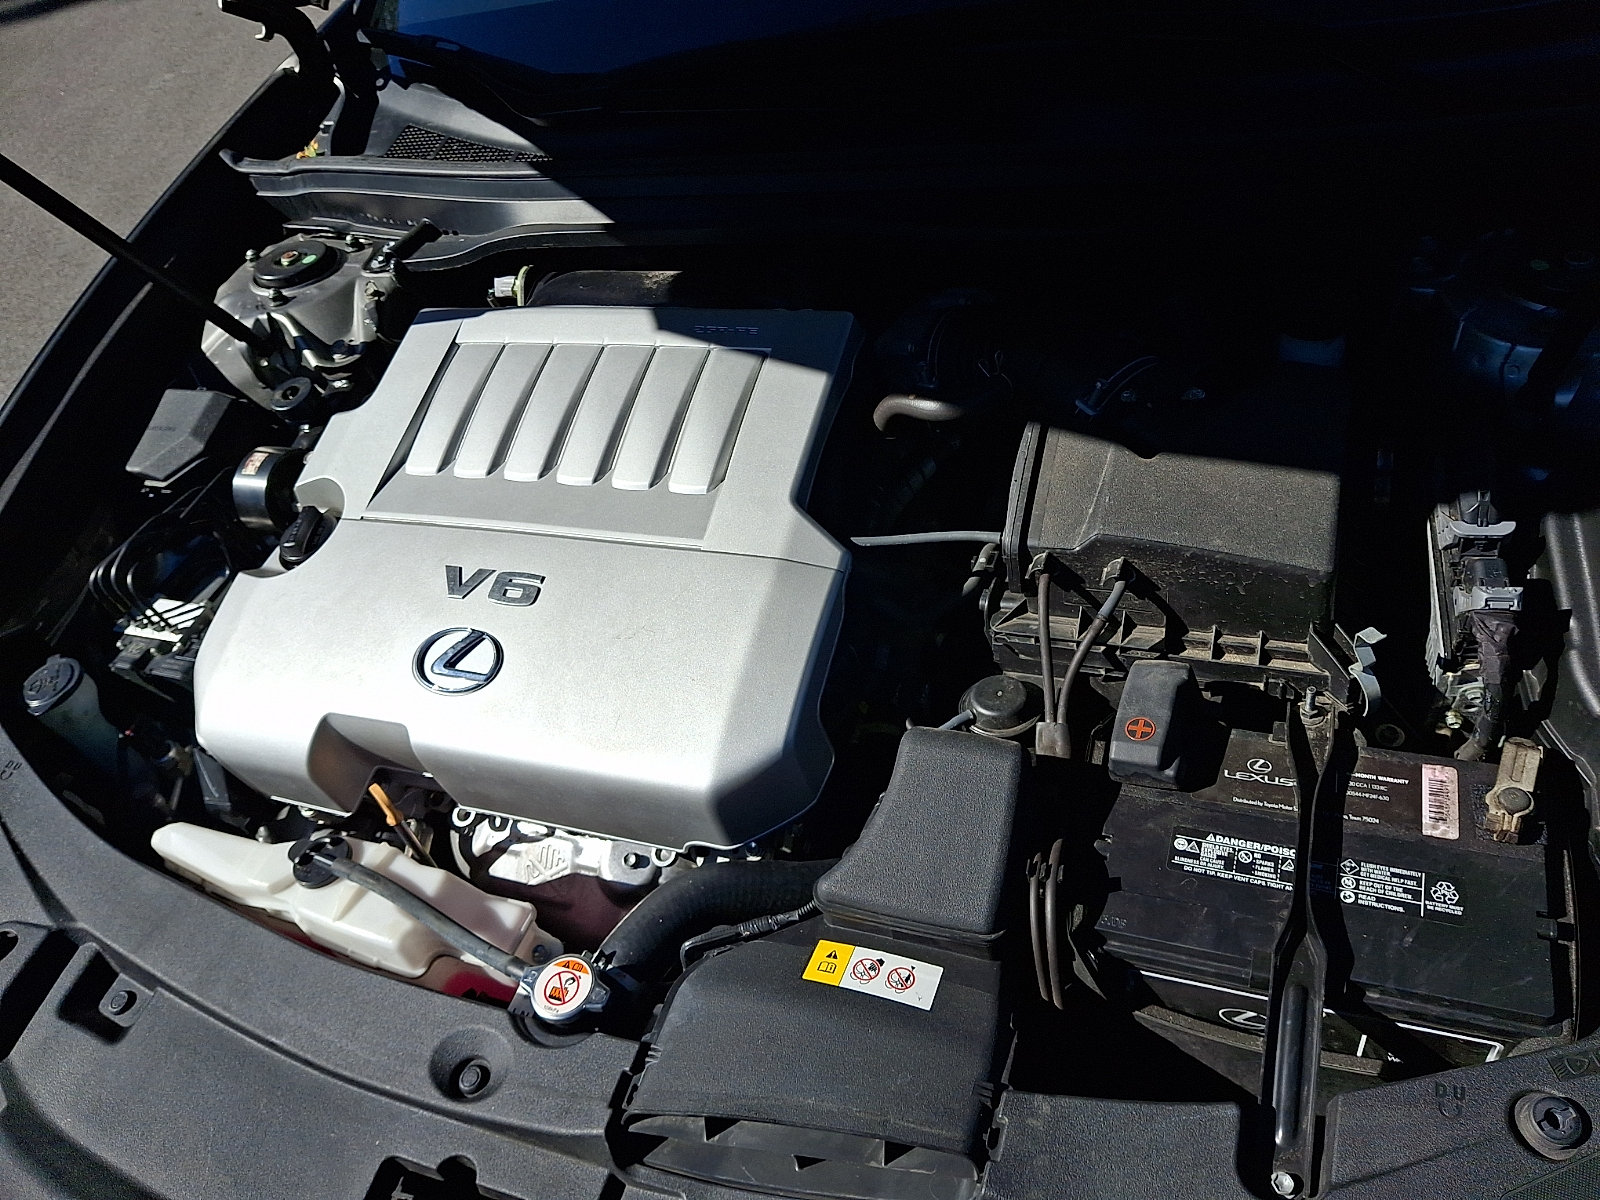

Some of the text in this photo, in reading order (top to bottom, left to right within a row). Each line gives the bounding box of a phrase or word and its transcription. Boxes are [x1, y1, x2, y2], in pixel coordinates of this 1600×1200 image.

[445, 565, 547, 607] V6
[1224, 769, 1296, 787] LEXUS
[1378, 776, 1409, 784] WARRANTY
[1215, 835, 1296, 856] DANGER/POISO
[1234, 875, 1249, 883] VENT
[1267, 881, 1284, 890] TIGHT
